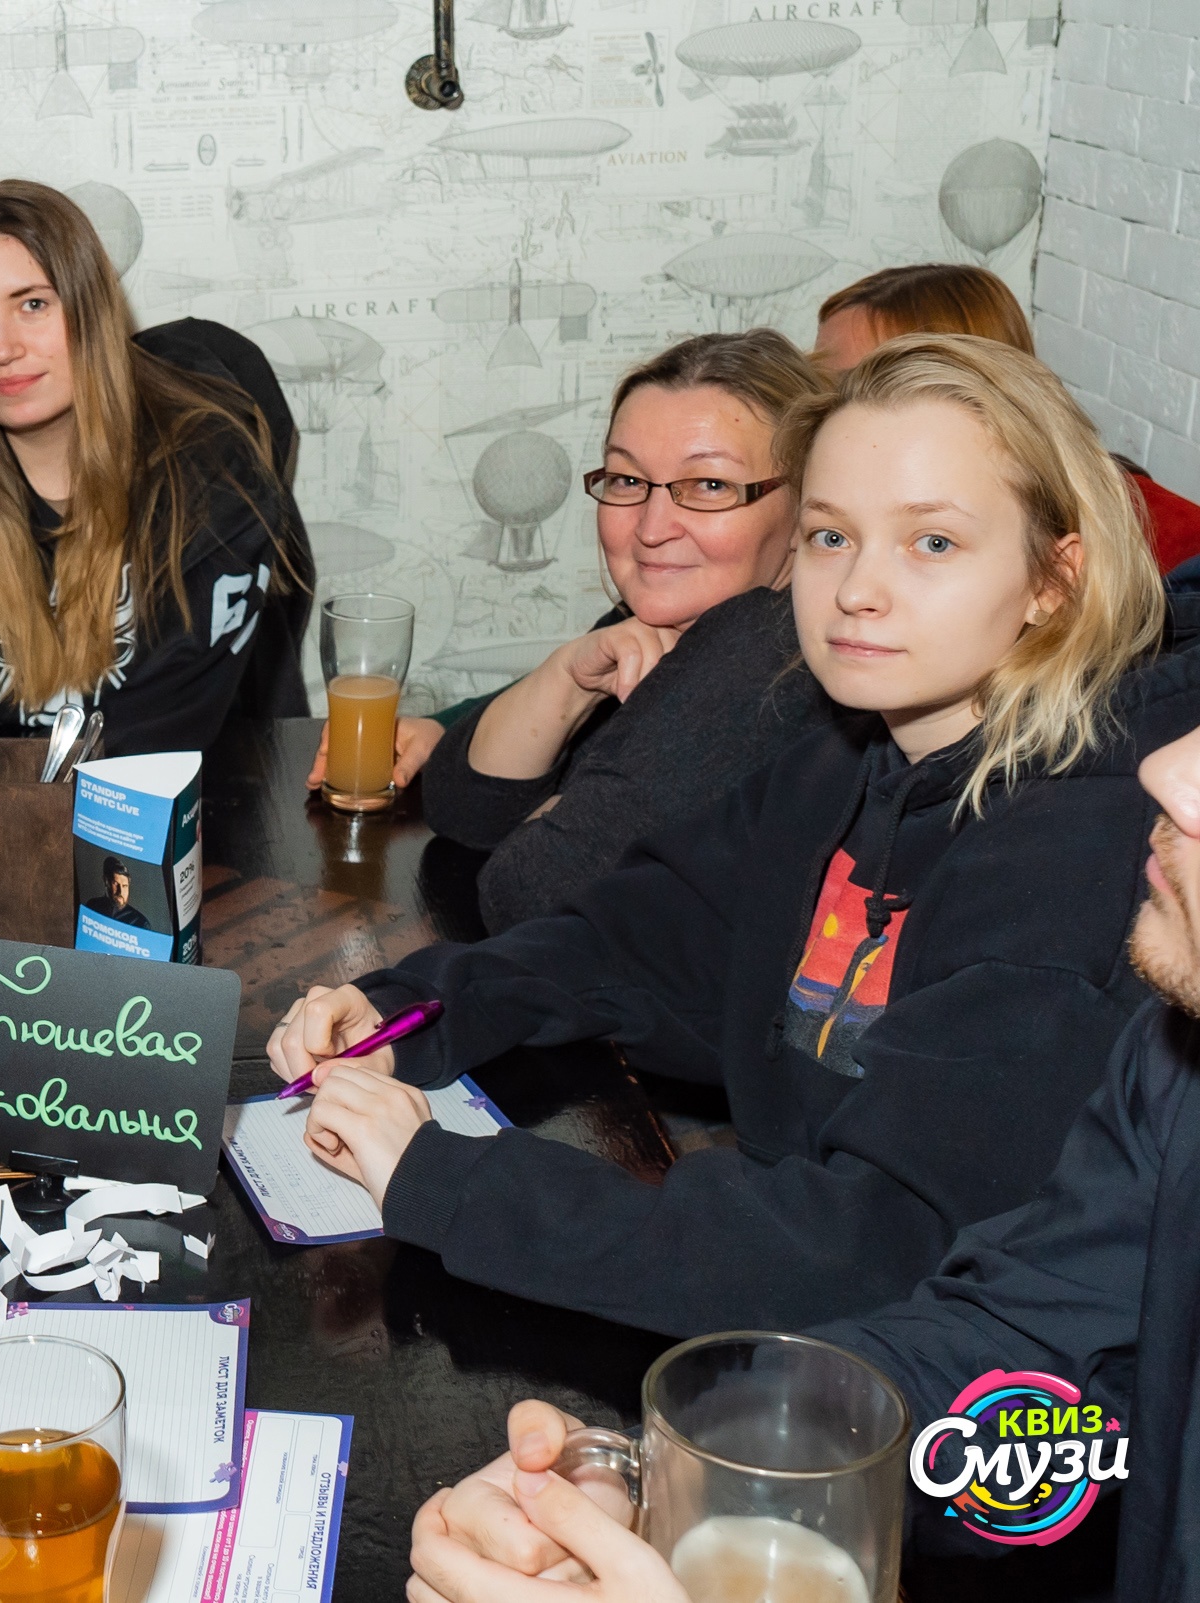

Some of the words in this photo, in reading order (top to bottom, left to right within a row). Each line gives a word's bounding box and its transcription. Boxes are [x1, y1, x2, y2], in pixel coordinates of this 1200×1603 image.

[607, 150, 688, 166] AVIATION
[290, 297, 437, 319] AIRCRAFT
[80, 778, 127, 801] STANDUP
[116, 801, 140, 817] LIVE
[81, 914, 139, 944] ПРОМОКОД
[218, 1356, 230, 1379] ЛИСТ
[216, 1381, 228, 1400] ДЛЯ
[213, 1401, 227, 1444] ЗАМЕТОК
[317, 1472, 332, 1509] ОТЗЫВЫ
[306, 1520, 326, 1589] ПРЕДЛОЖЕНИЯ
